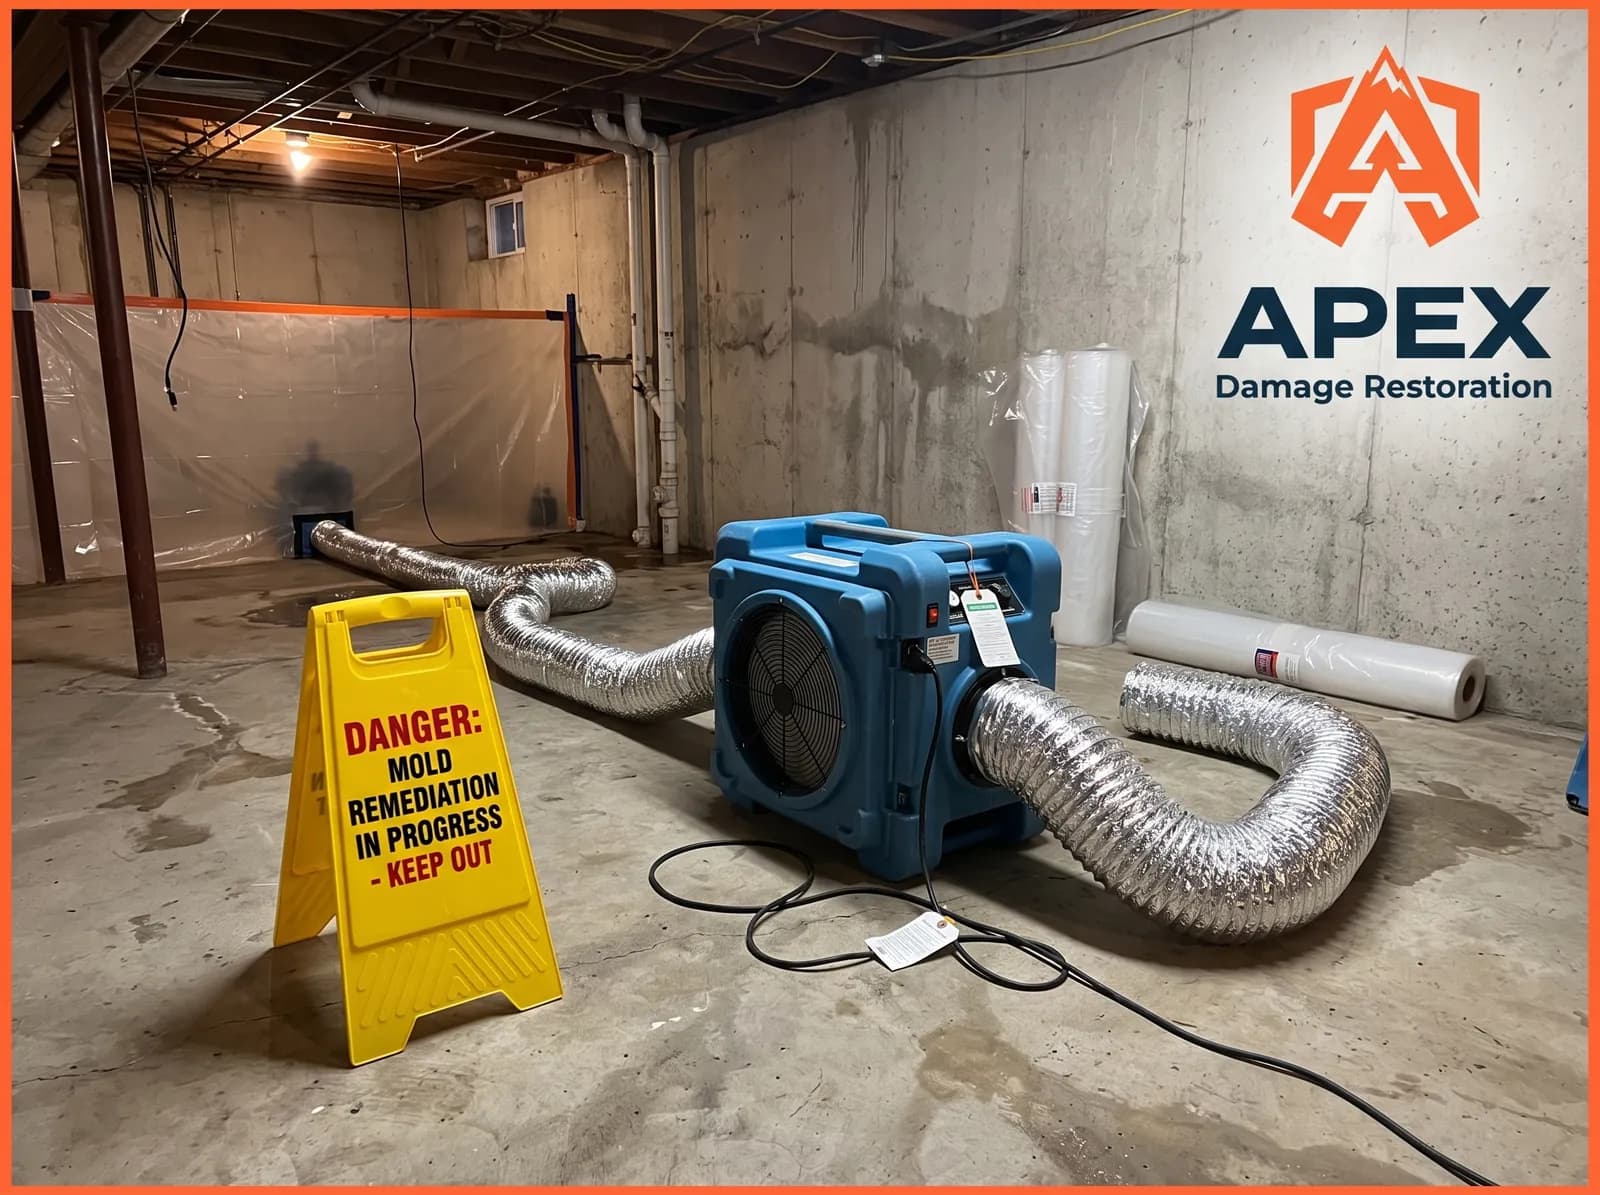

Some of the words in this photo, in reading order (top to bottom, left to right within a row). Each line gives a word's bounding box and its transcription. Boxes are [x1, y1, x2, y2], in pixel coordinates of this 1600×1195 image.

[344, 704, 482, 756] DANGER:
[388, 749, 452, 783] MOLD
[348, 772, 499, 826] REMEDIATION
[356, 831, 381, 860] IN
[388, 804, 501, 853] PROGRESS
[387, 851, 443, 888] KEEP
[451, 839, 492, 872] OUT
